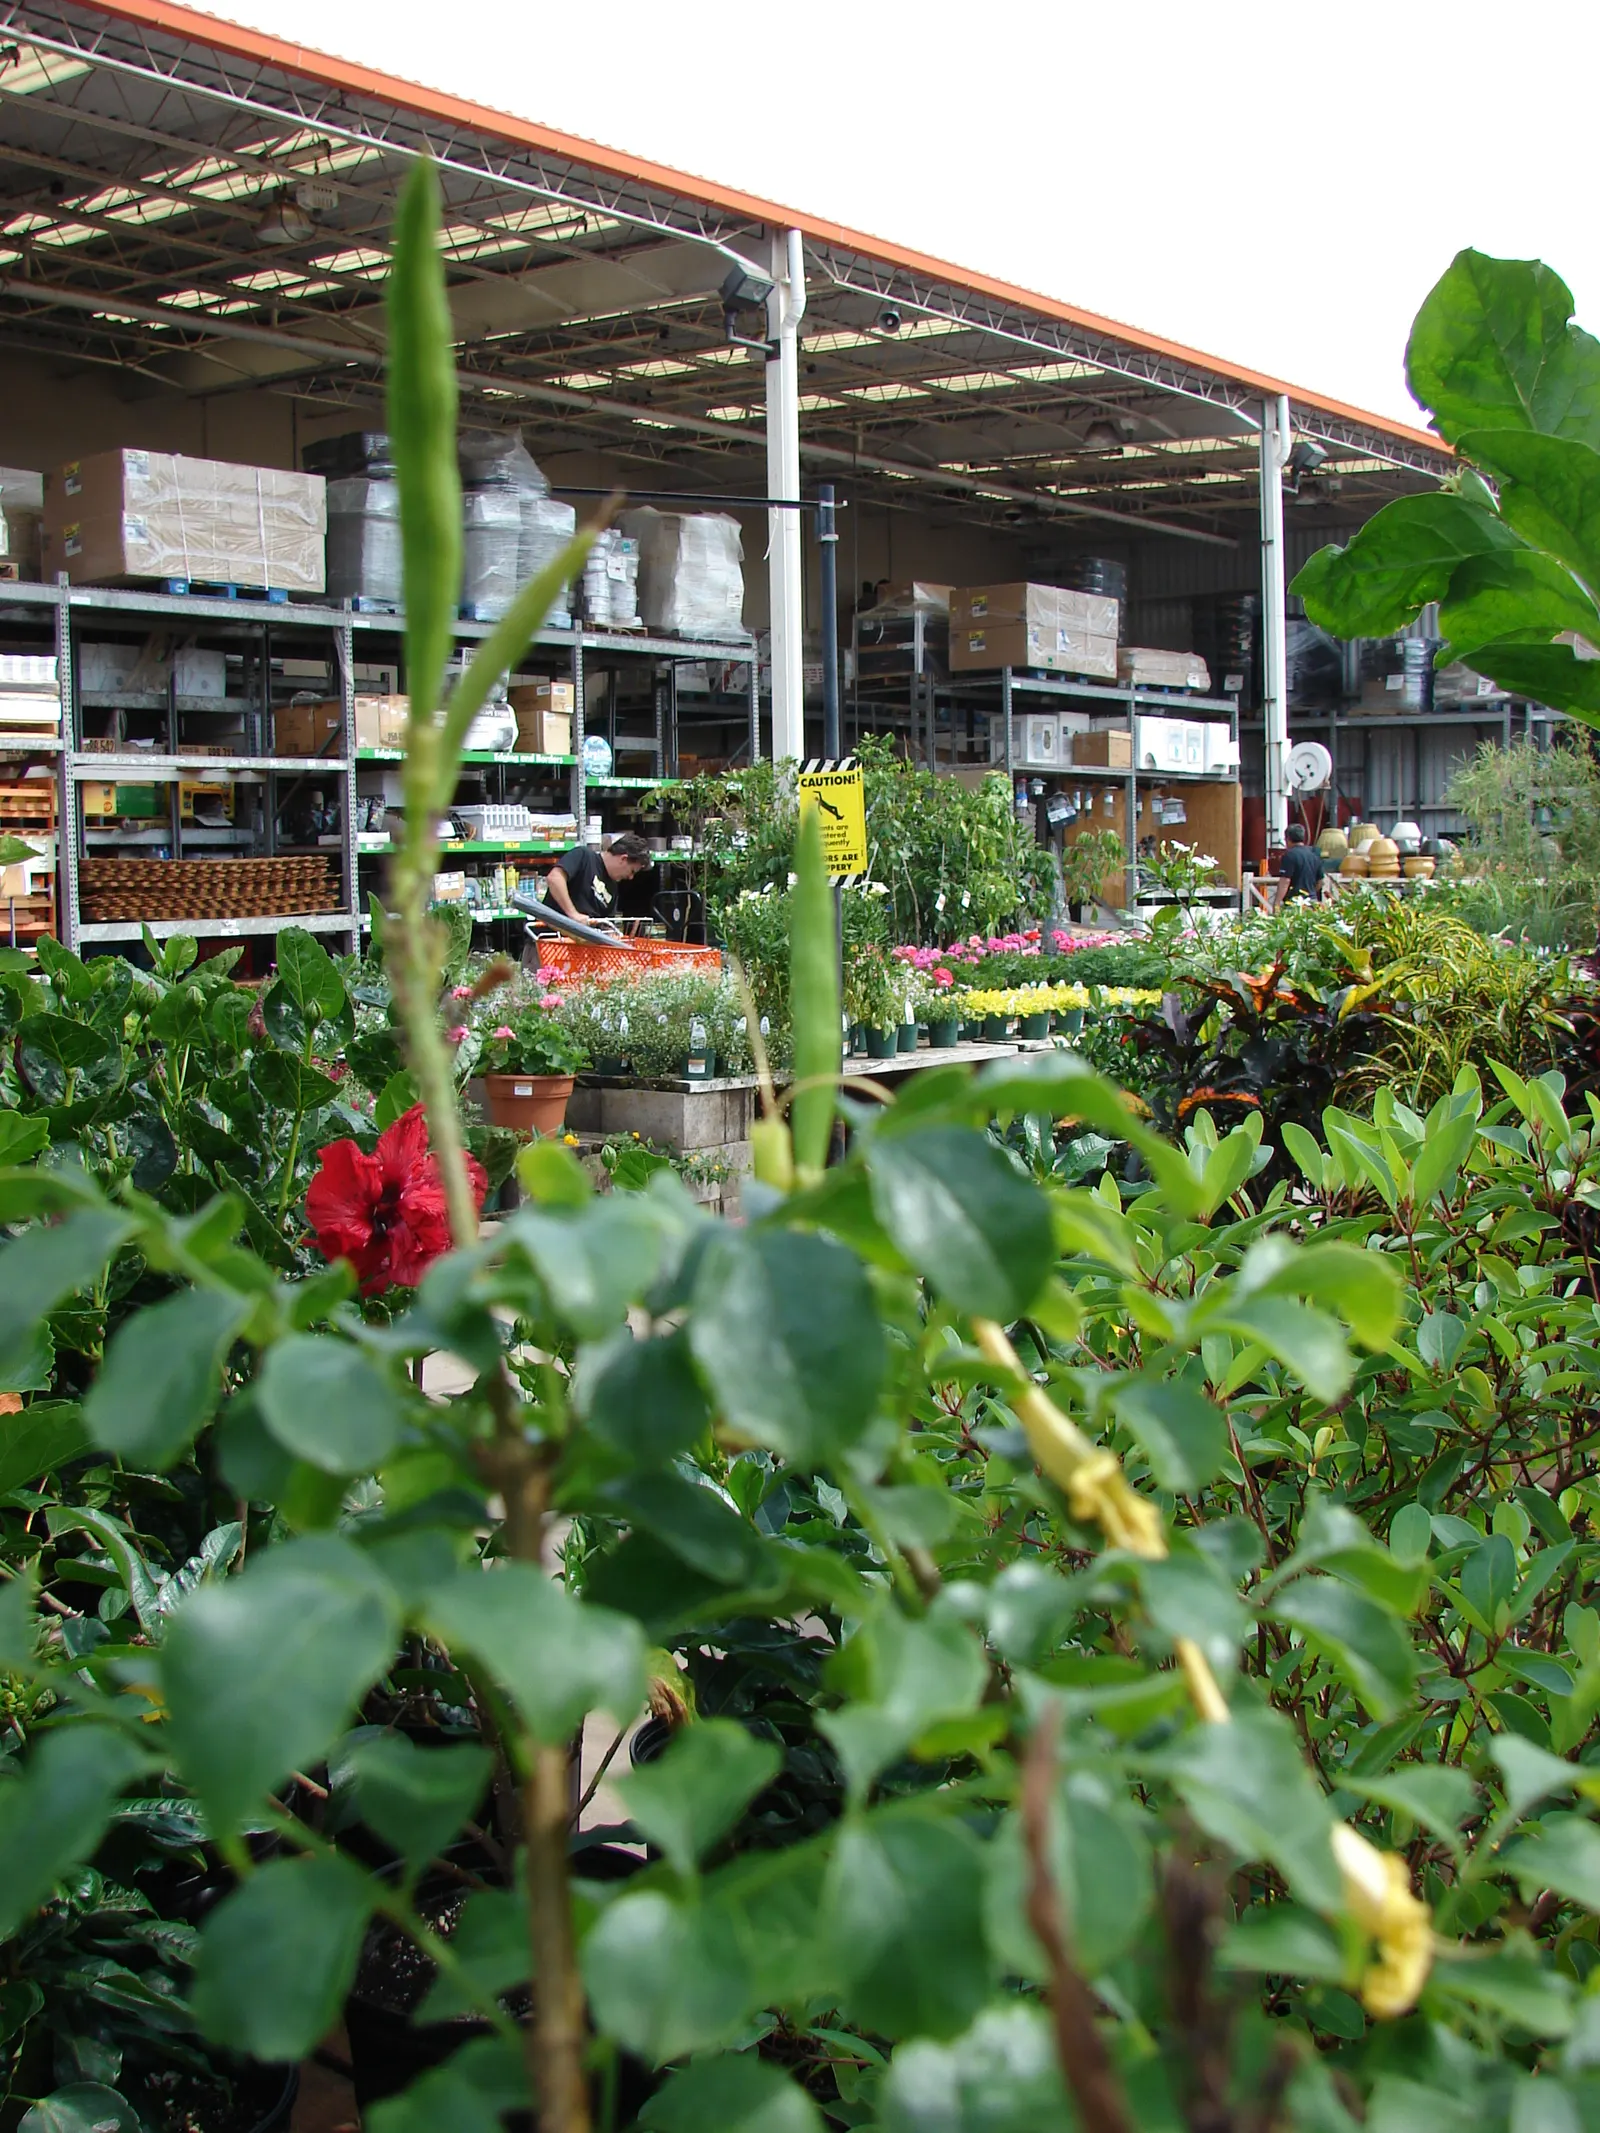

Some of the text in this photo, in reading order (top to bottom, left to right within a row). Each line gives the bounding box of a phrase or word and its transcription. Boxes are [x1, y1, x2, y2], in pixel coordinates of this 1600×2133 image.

[374, 748, 402, 760] Edging
[520, 753, 535, 763] and
[535, 754, 563, 765] Borders
[598, 777, 662, 788] Edging and Borders
[824, 838, 850, 848] quently
[824, 853, 859, 862] ORS ARE
[826, 863, 852, 871] PPERY
